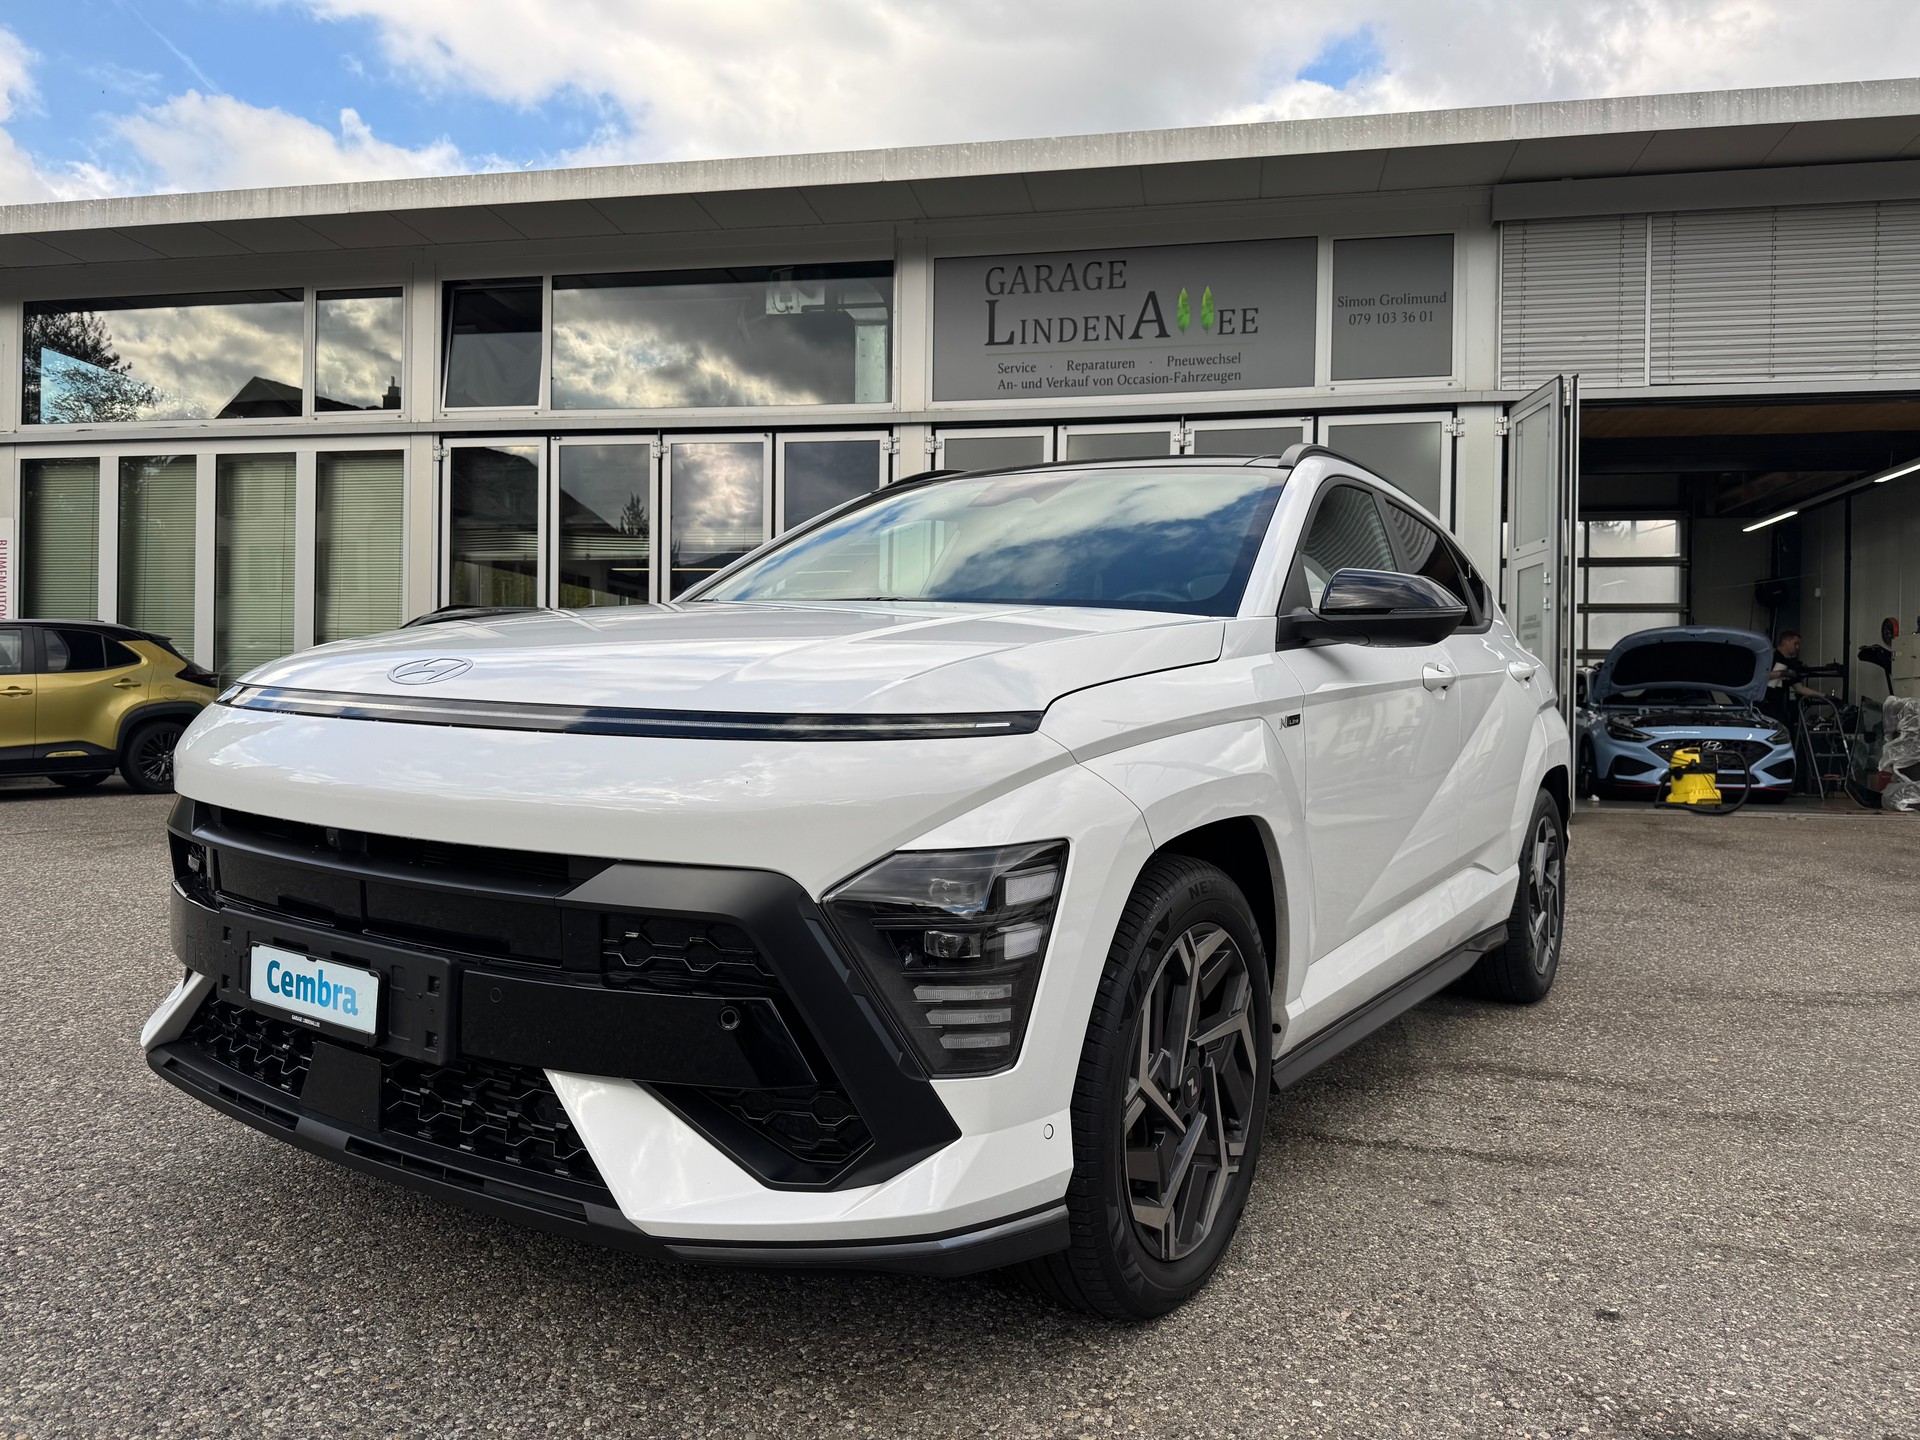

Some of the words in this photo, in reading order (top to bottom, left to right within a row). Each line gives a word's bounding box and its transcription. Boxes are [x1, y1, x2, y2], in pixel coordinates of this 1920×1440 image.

[985, 260, 1127, 296] GARAGE
[1337, 295, 1376, 307] Simon
[1379, 291, 1447, 306] Grolimund
[1348, 313, 1371, 325] 079
[1377, 311, 1397, 324] 103
[1401, 311, 1416, 323] 36
[1419, 310, 1433, 322] 01
[997, 362, 1037, 374] Service
[1067, 358, 1135, 373] Reparaturen
[1167, 352, 1241, 367] Pneuwechsel
[997, 379, 1017, 390] An-
[1021, 377, 1042, 389] und
[1046, 375, 1090, 388] Verkauf
[1092, 377, 1113, 387] von
[1117, 371, 1241, 387] Occasion-Fahrzeugen
[267, 960, 358, 1016] Cembra
